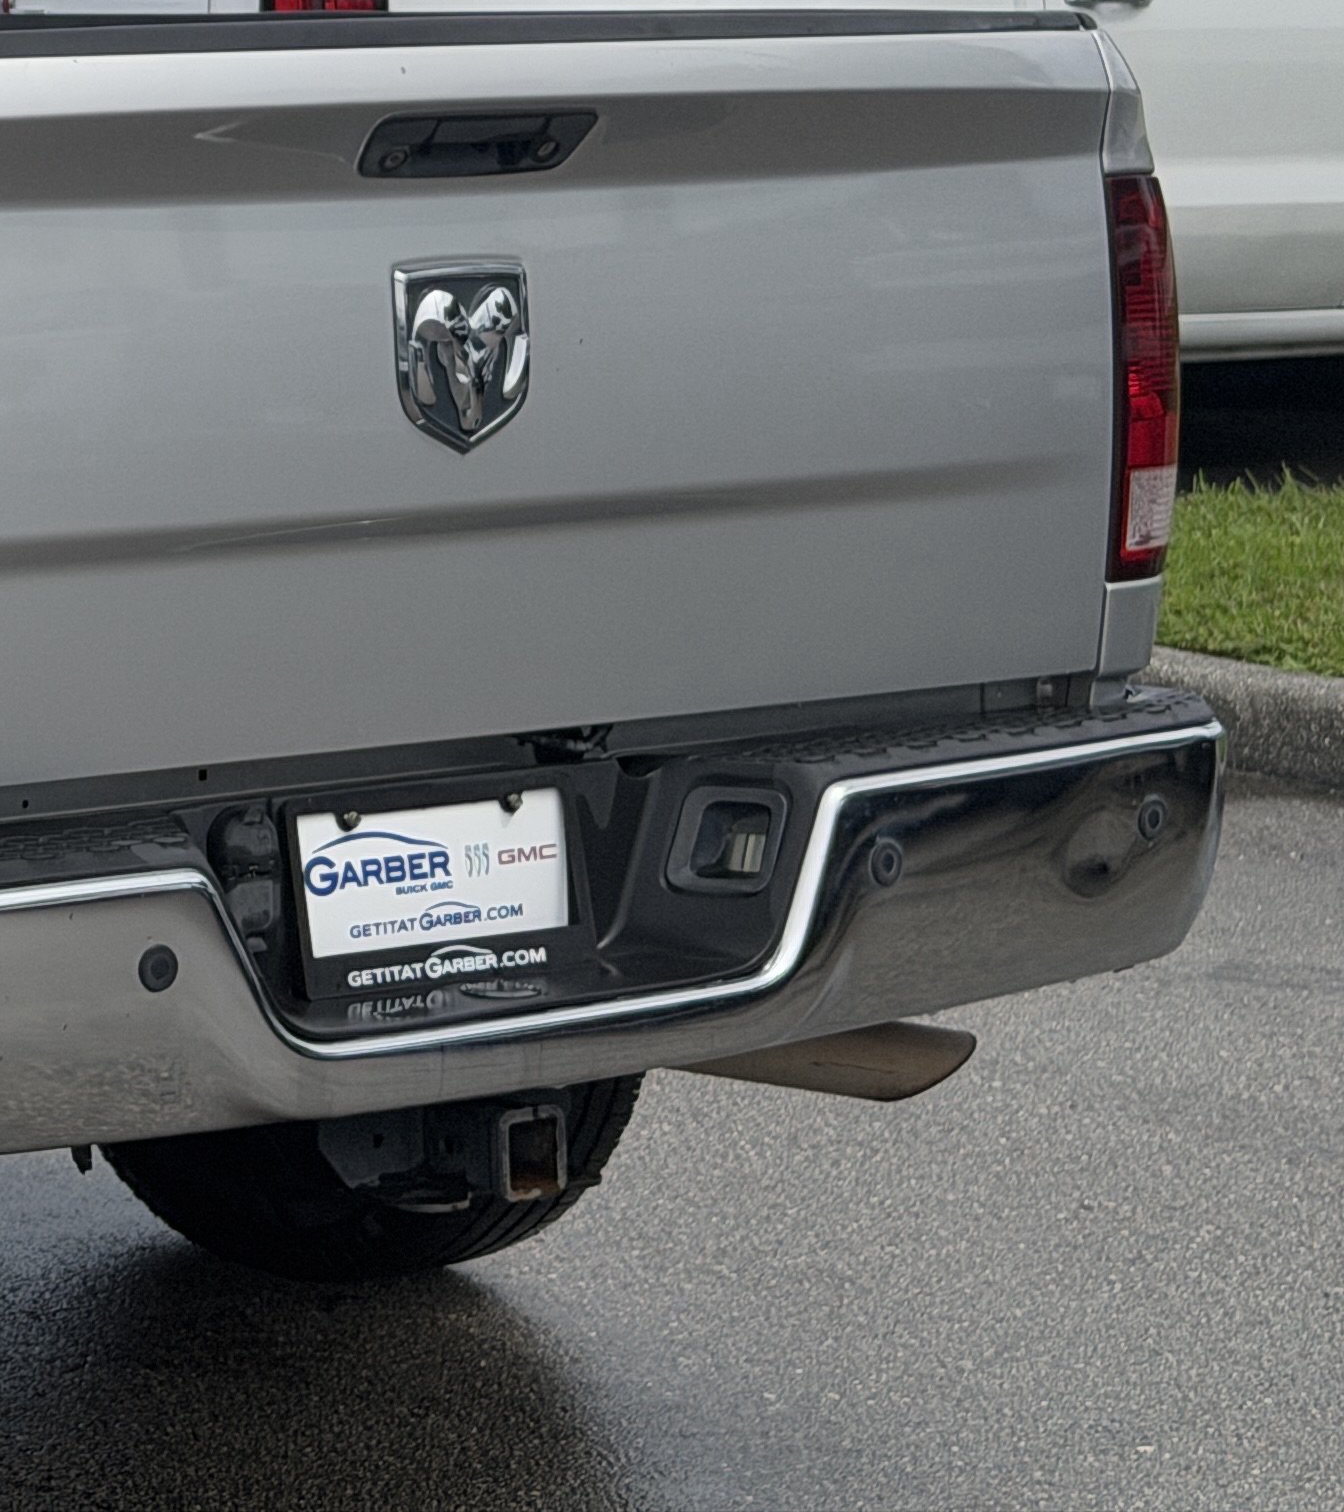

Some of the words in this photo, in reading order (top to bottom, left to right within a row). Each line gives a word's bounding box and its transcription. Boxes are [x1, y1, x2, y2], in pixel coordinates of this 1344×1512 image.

[497, 843, 558, 866] GMC
[304, 850, 452, 897] GARBER
[395, 883, 428, 896] BUICK
[430, 880, 454, 893] GMC
